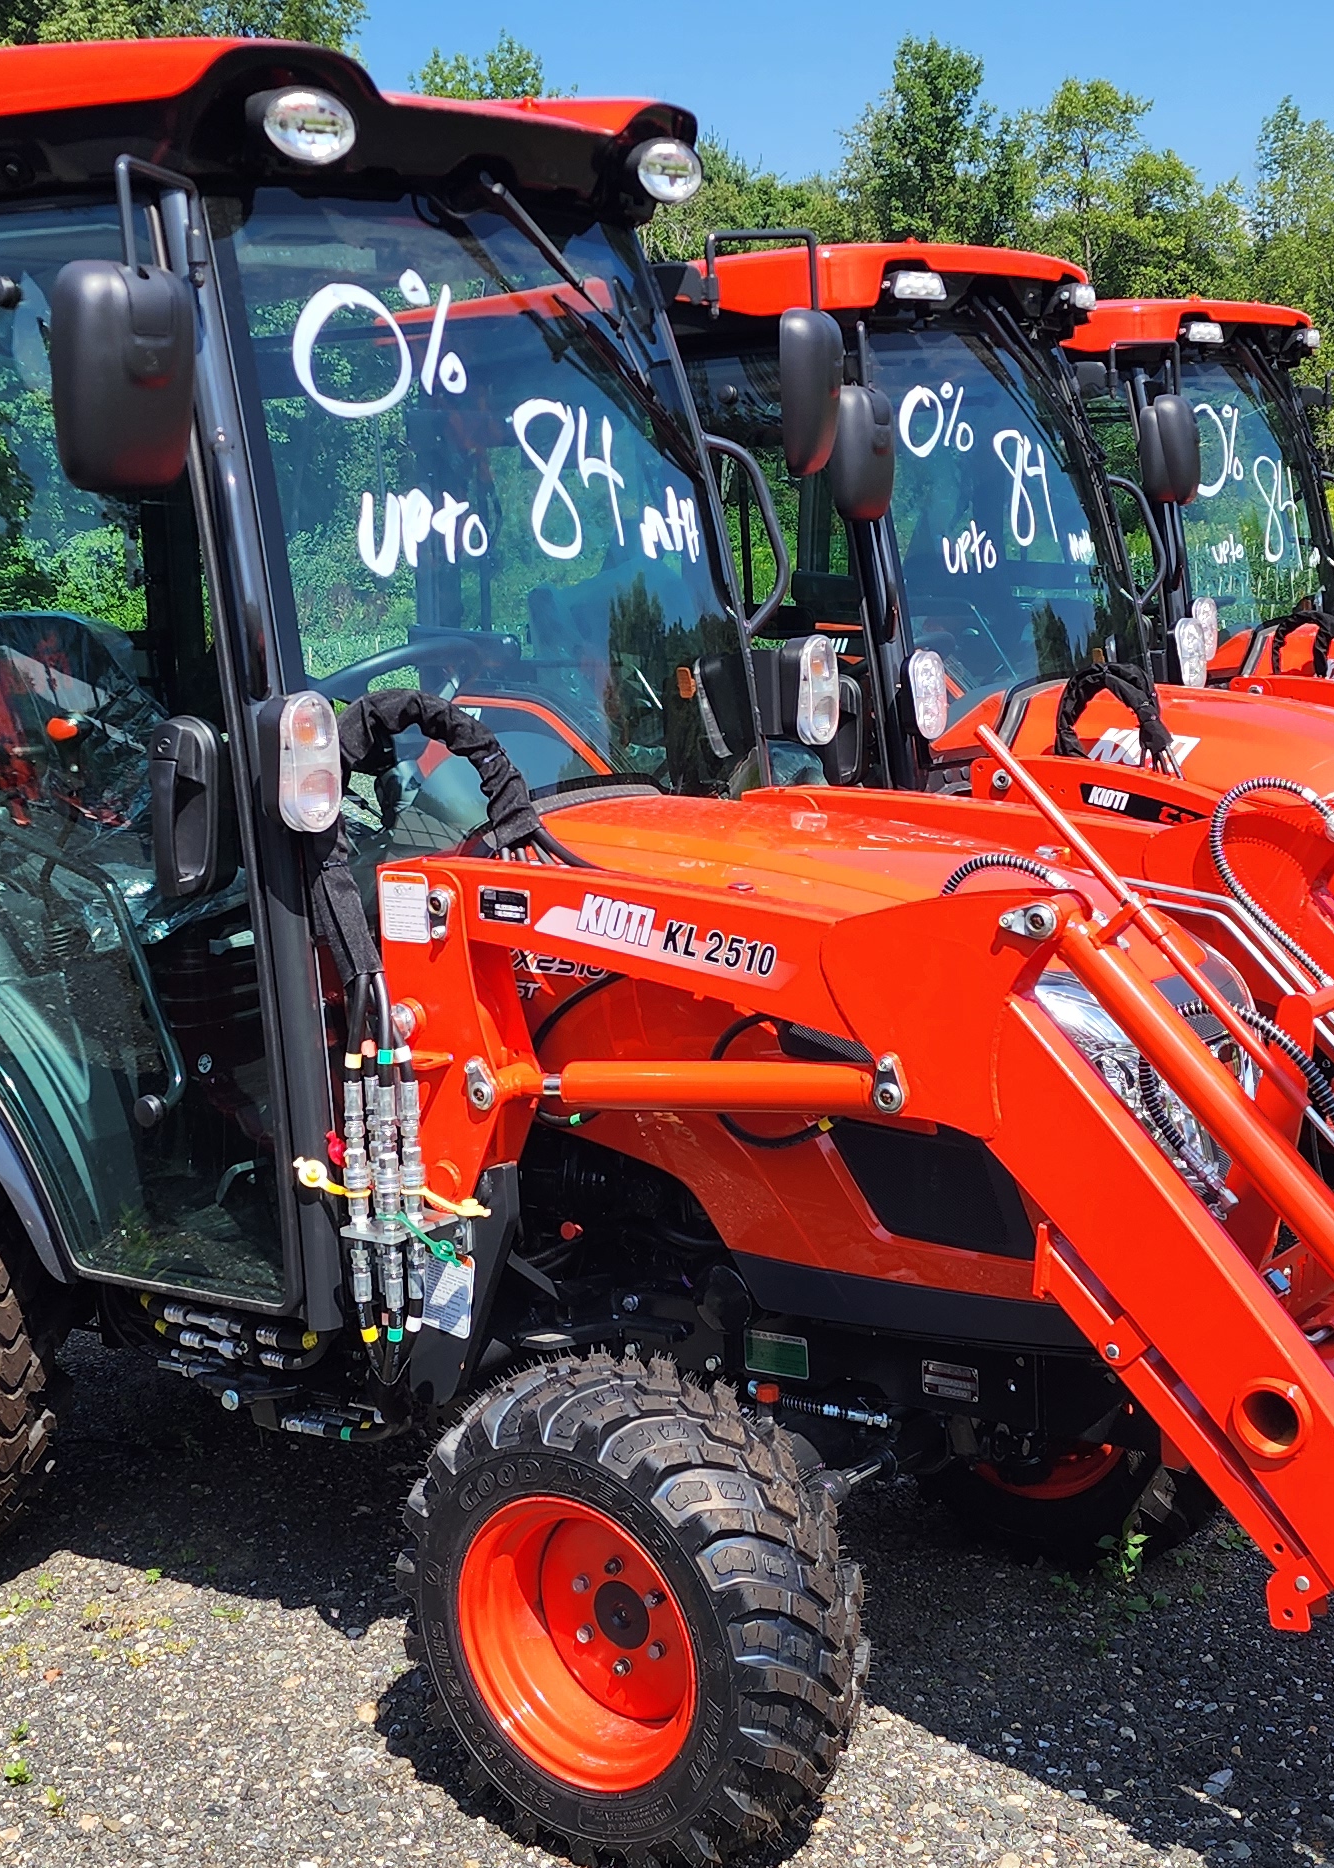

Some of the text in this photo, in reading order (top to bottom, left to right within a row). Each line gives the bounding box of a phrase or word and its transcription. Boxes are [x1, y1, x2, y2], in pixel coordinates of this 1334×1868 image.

[292, 268, 467, 419] 0%
[898, 381, 974, 458] 0%
[512, 397, 625, 560] 84
[992, 429, 1058, 547] 84
[1253, 455, 1304, 571] 84
[1088, 785, 1130, 811] KIOTI
[576, 893, 657, 947] KIOTI
[661, 918, 699, 961] KL
[701, 929, 778, 978] 2510
